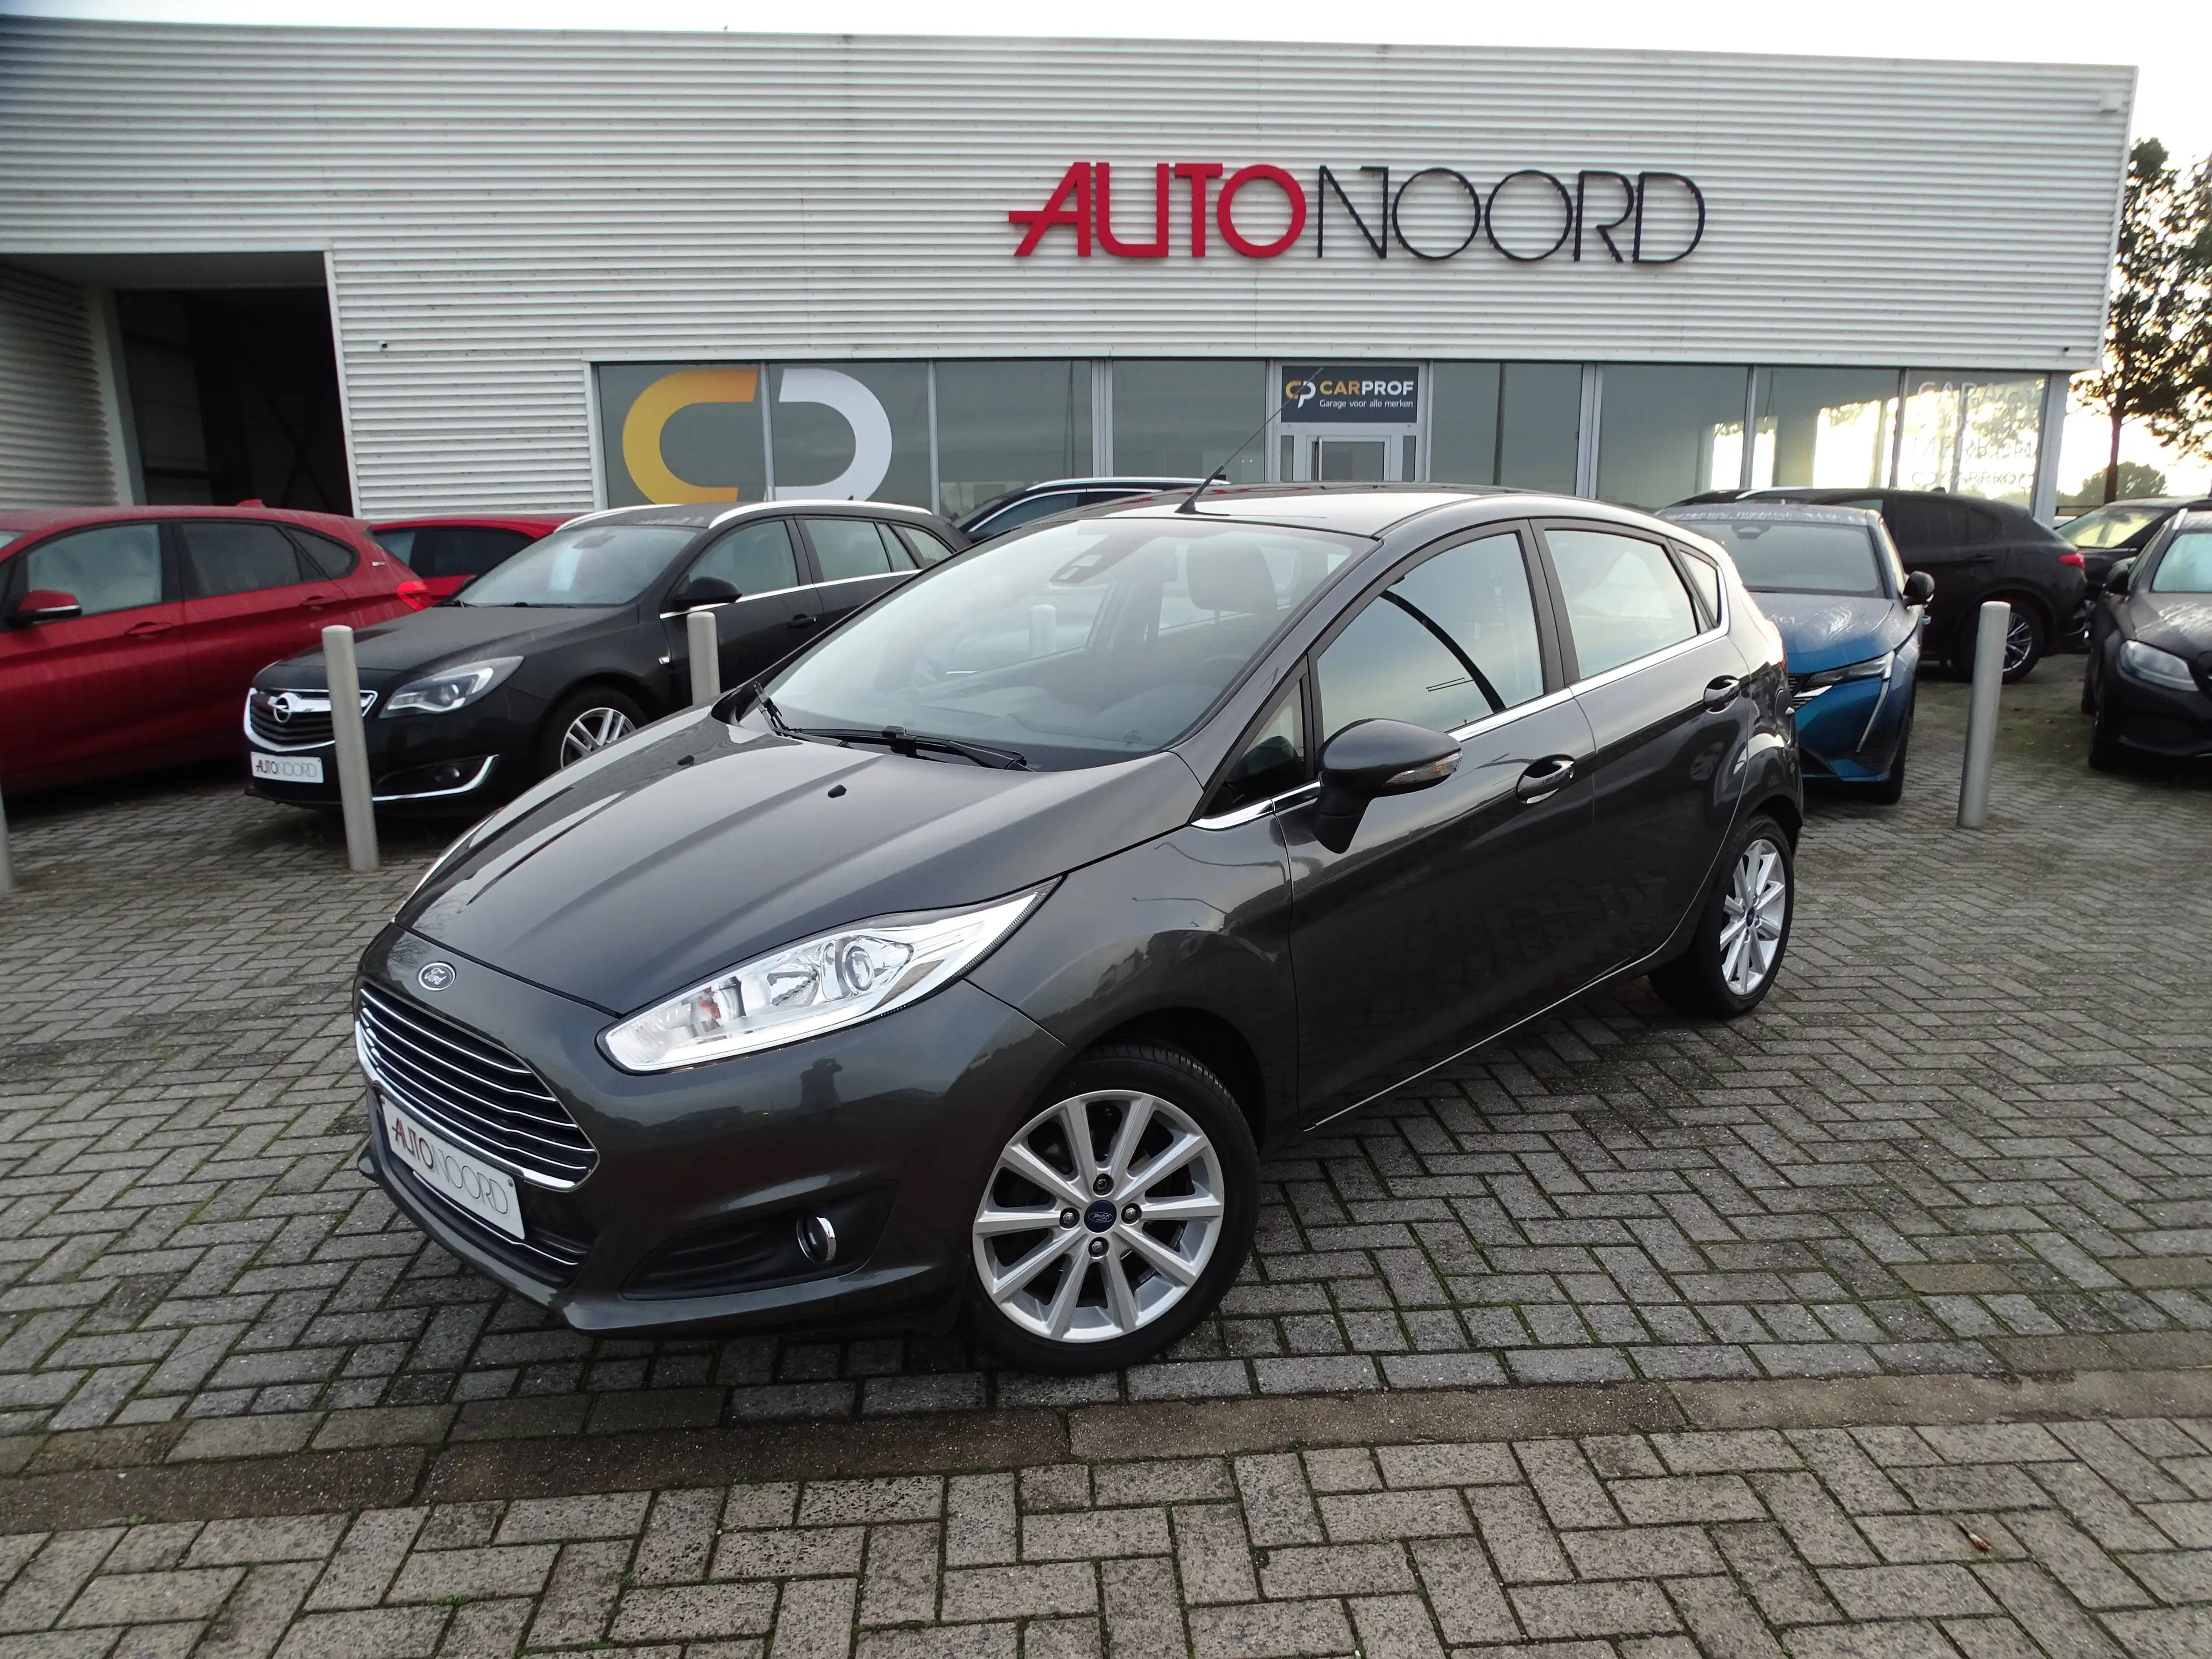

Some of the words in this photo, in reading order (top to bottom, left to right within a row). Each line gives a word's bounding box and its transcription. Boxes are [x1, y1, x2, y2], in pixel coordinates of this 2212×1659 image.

[1319, 380, 1414, 396] CARPROF
[1319, 399, 1346, 410] Garage
[1349, 400, 1366, 408] voor
[1369, 399, 1382, 408] alle
[1384, 399, 1414, 408] merken
[424, 967, 448, 985] Ford
